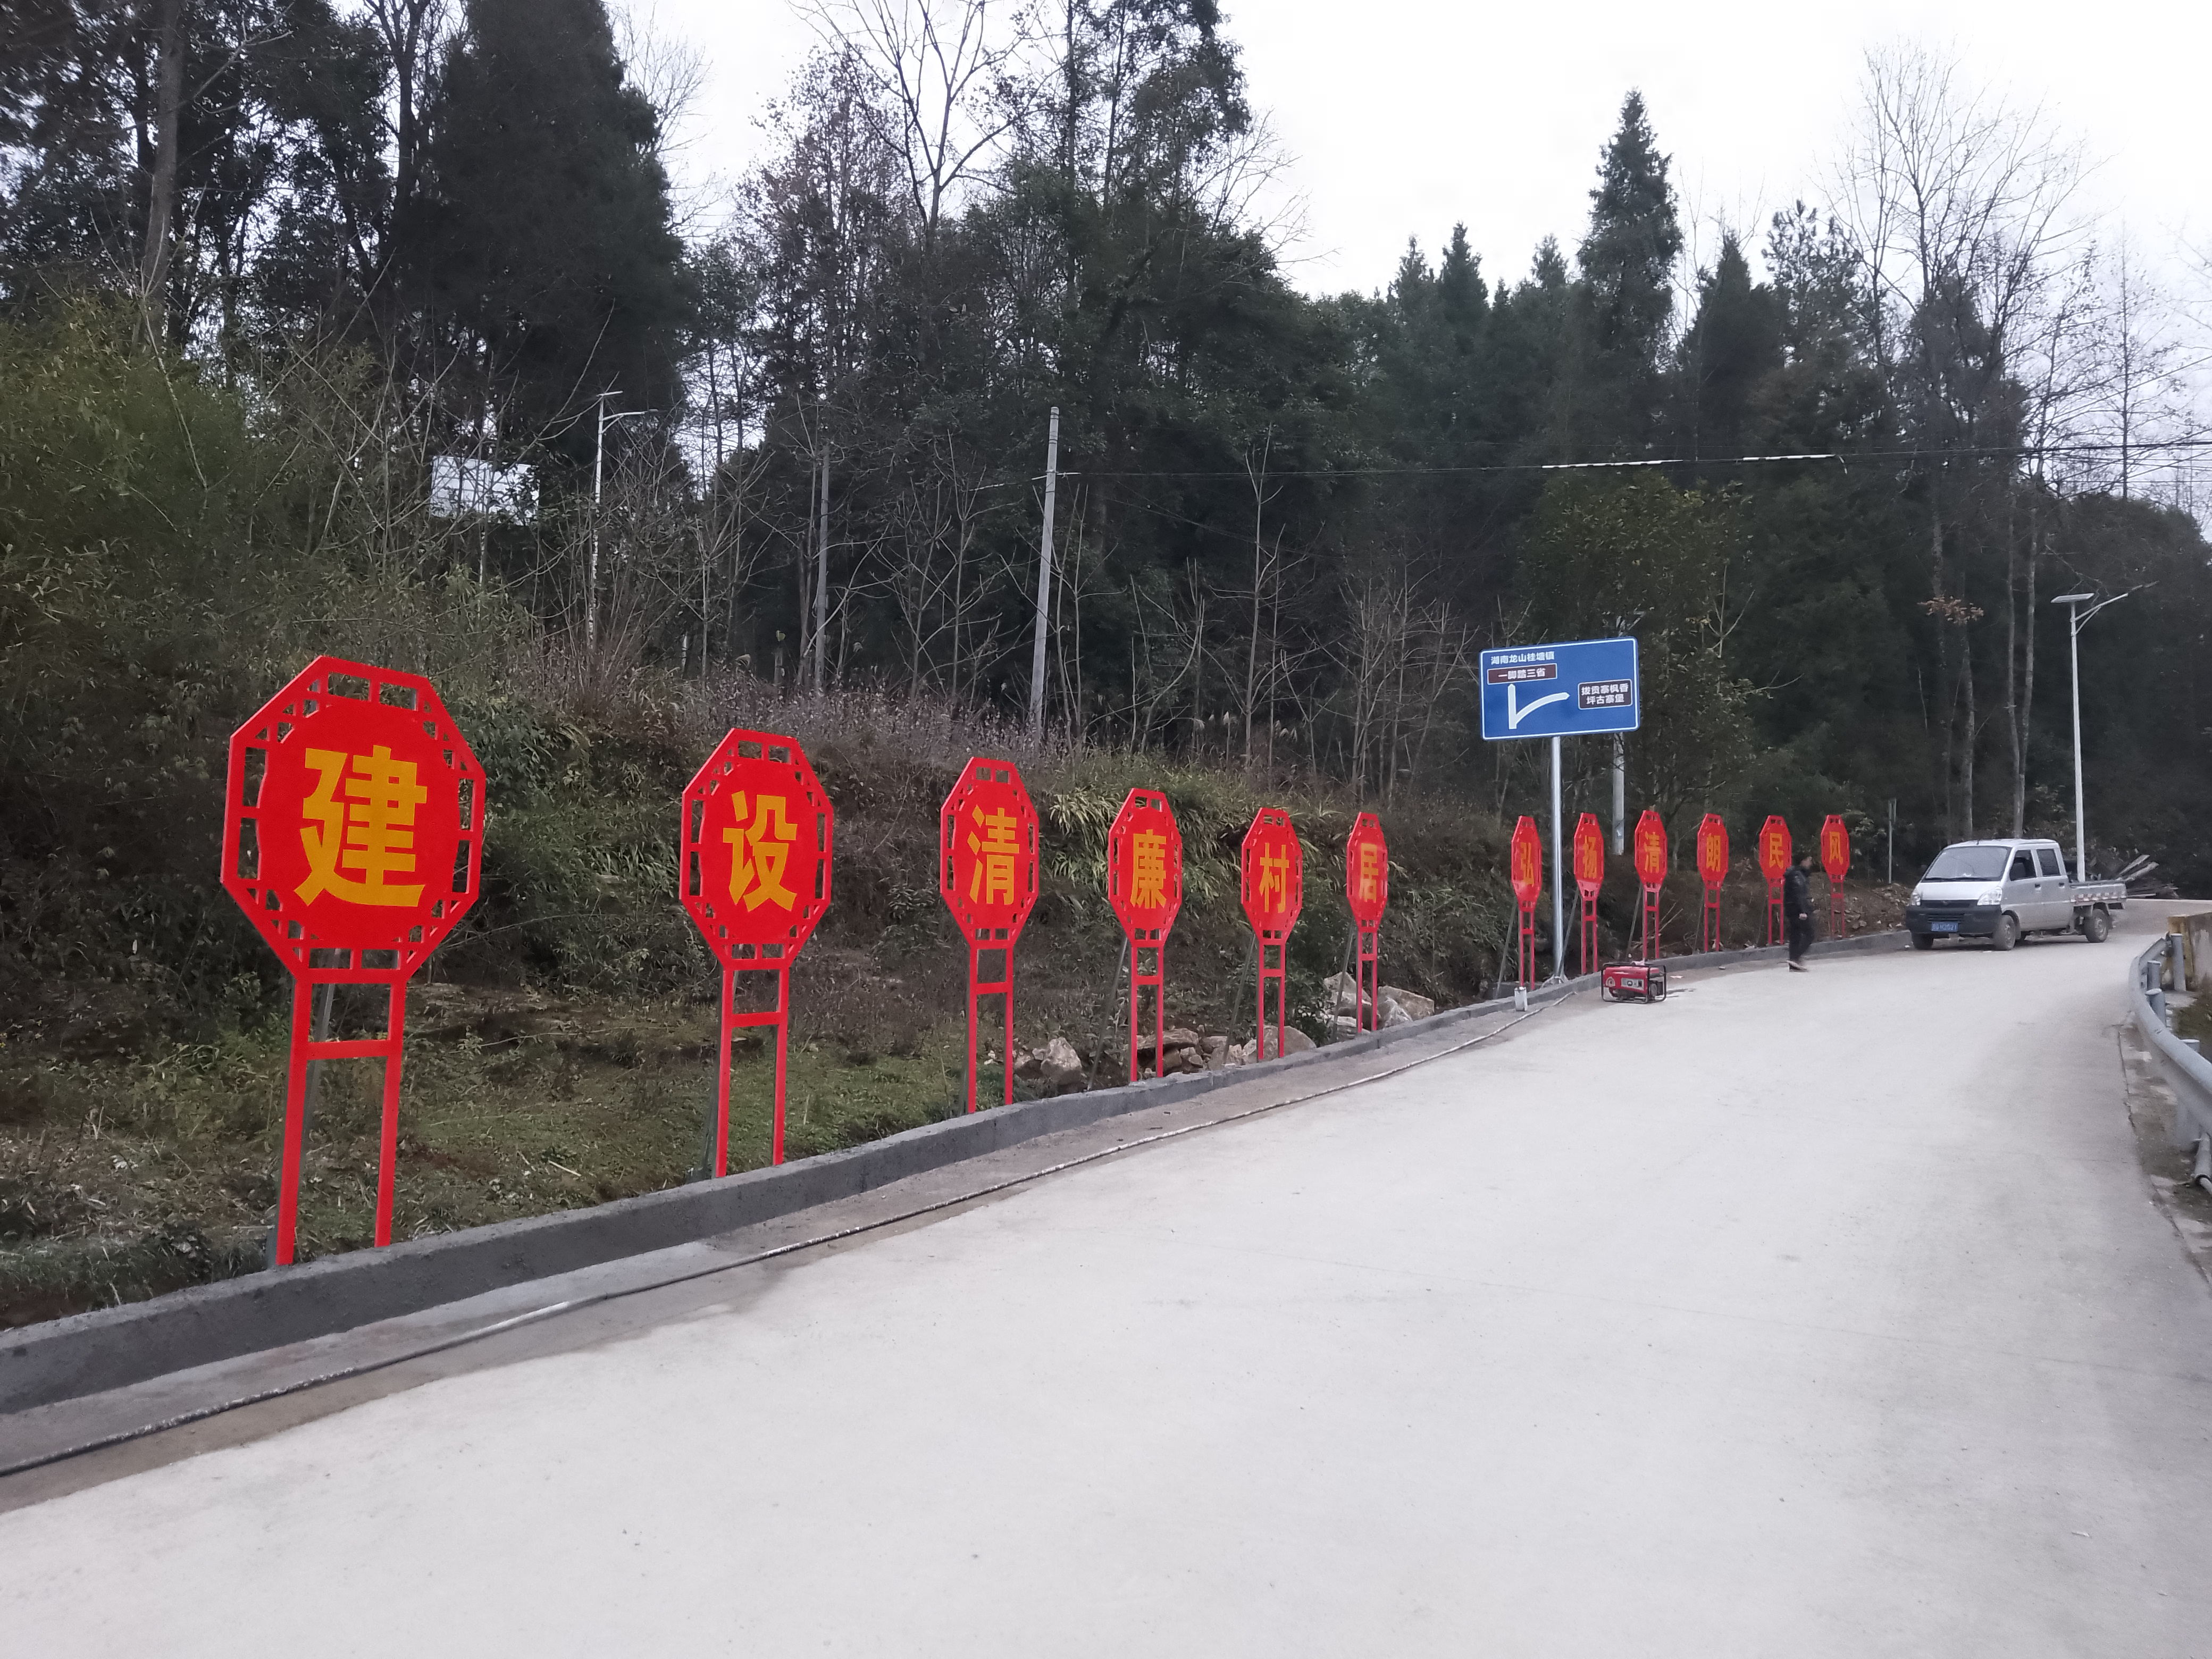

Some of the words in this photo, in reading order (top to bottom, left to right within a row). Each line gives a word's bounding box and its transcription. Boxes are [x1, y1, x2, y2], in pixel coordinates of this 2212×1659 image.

[1490, 651, 1555, 665] 湖南龙山桂塘镇
[295, 745, 427, 906] 建
[723, 791, 797, 911] 设
[968, 806, 1019, 904] 清
[1130, 830, 1167, 908] 廉
[1520, 842, 1534, 886] 弘
[1582, 835, 1597, 878] 扬
[1644, 832, 1661, 873] 清
[1706, 833, 1721, 872] 朗
[1769, 833, 1784, 868] 民
[1829, 832, 1844, 864] 风
[1259, 843, 1289, 912] 村
[1359, 843, 1379, 902] 居
